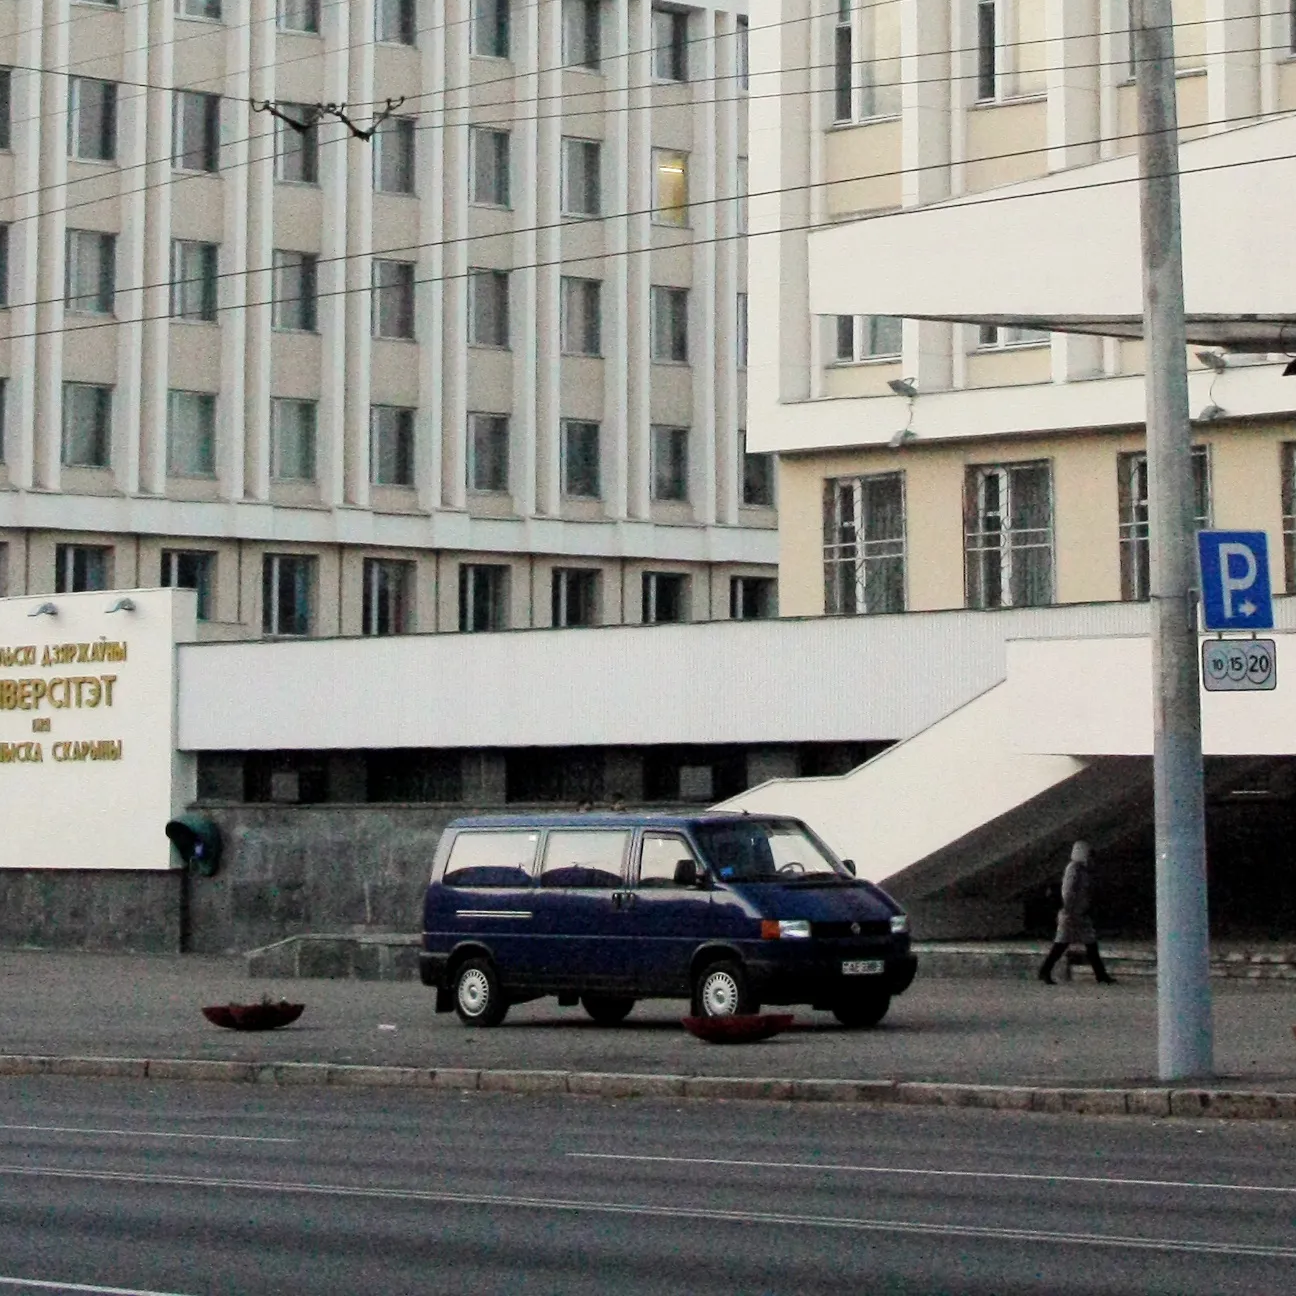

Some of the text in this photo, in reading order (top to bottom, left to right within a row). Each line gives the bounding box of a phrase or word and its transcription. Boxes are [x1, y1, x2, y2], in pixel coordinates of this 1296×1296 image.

[1219, 543, 1257, 619] P
[1212, 655, 1269, 673] 10 15 20
